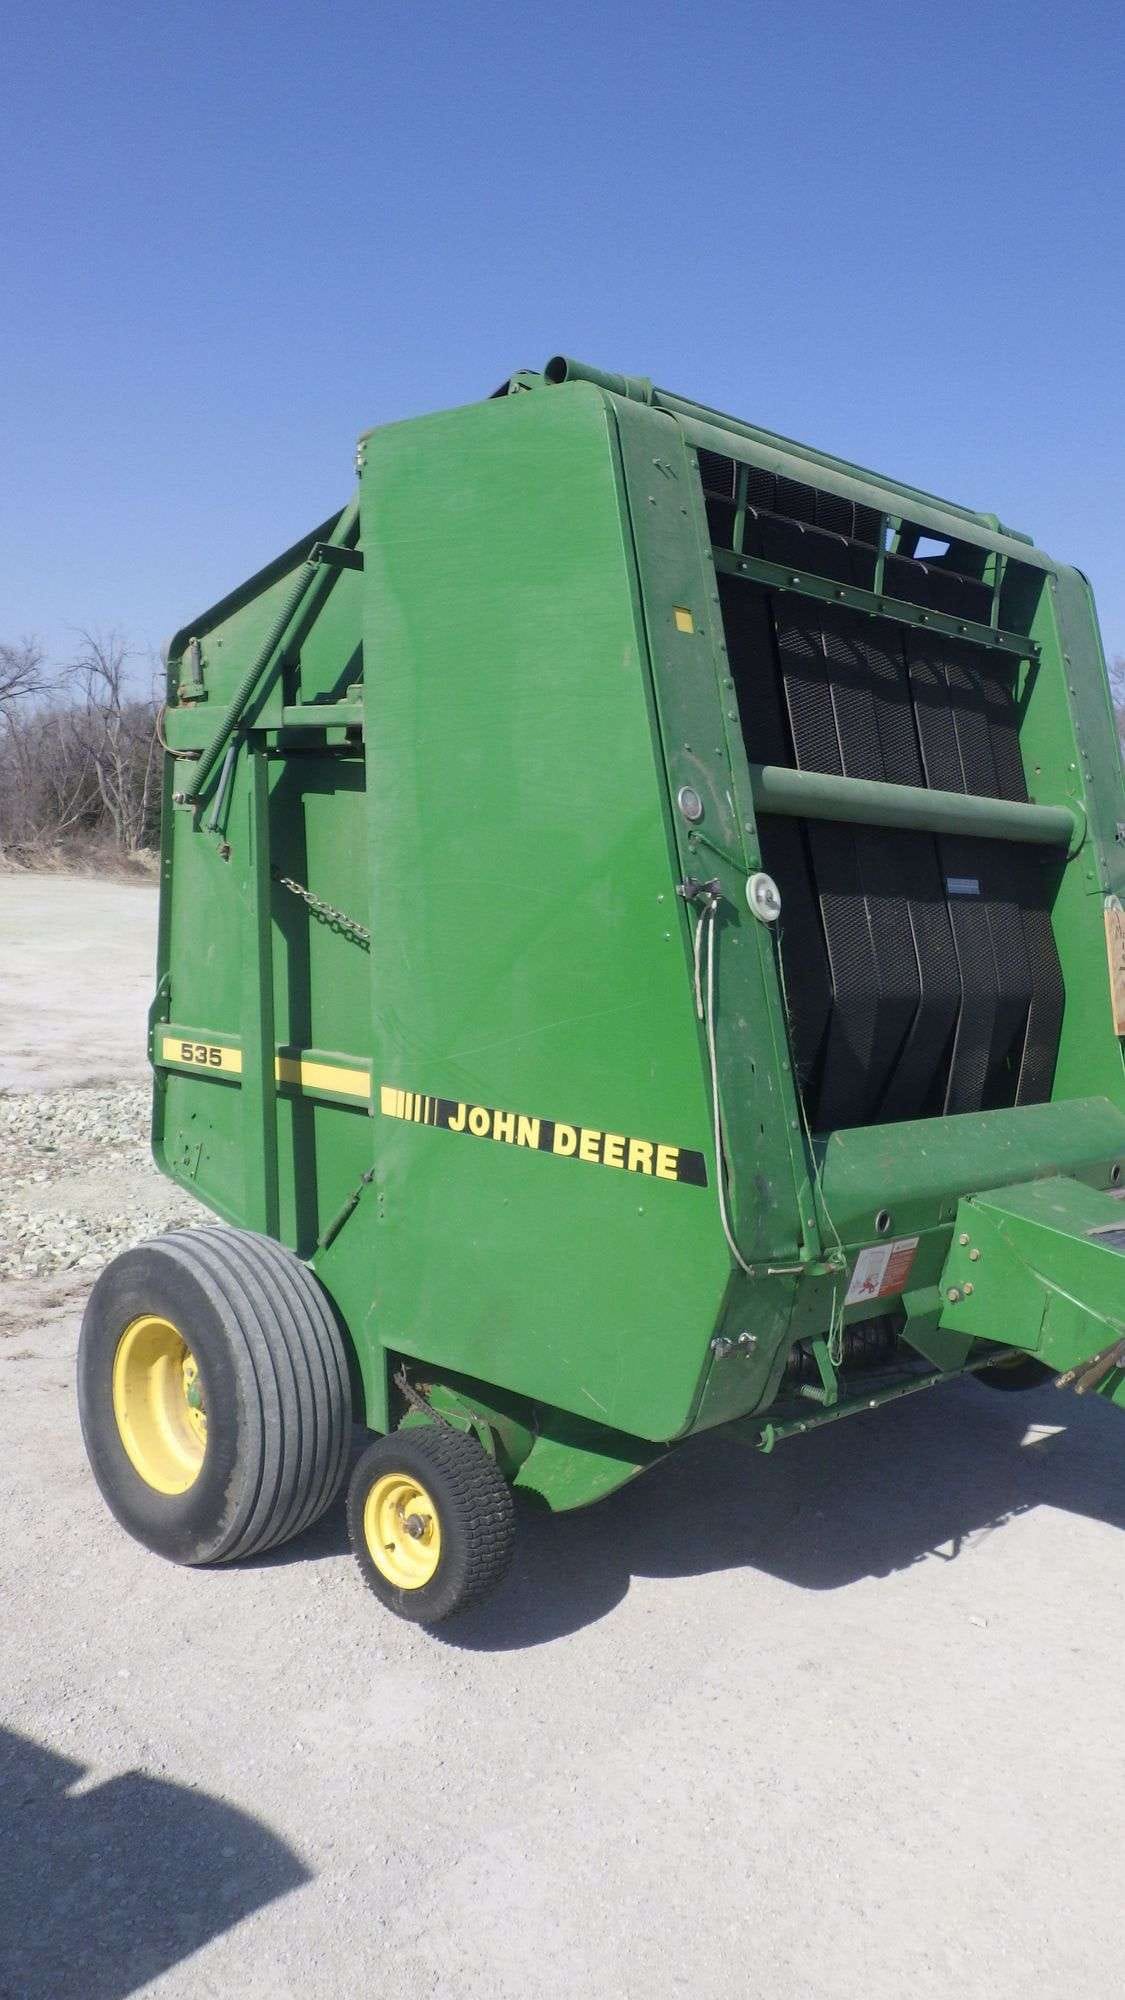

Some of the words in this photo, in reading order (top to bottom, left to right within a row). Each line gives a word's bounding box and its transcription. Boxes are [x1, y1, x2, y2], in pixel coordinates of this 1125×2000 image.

[181, 1043, 222, 1067] 535
[448, 1103, 540, 1149] JOHN
[552, 1123, 680, 1181] DEERE
